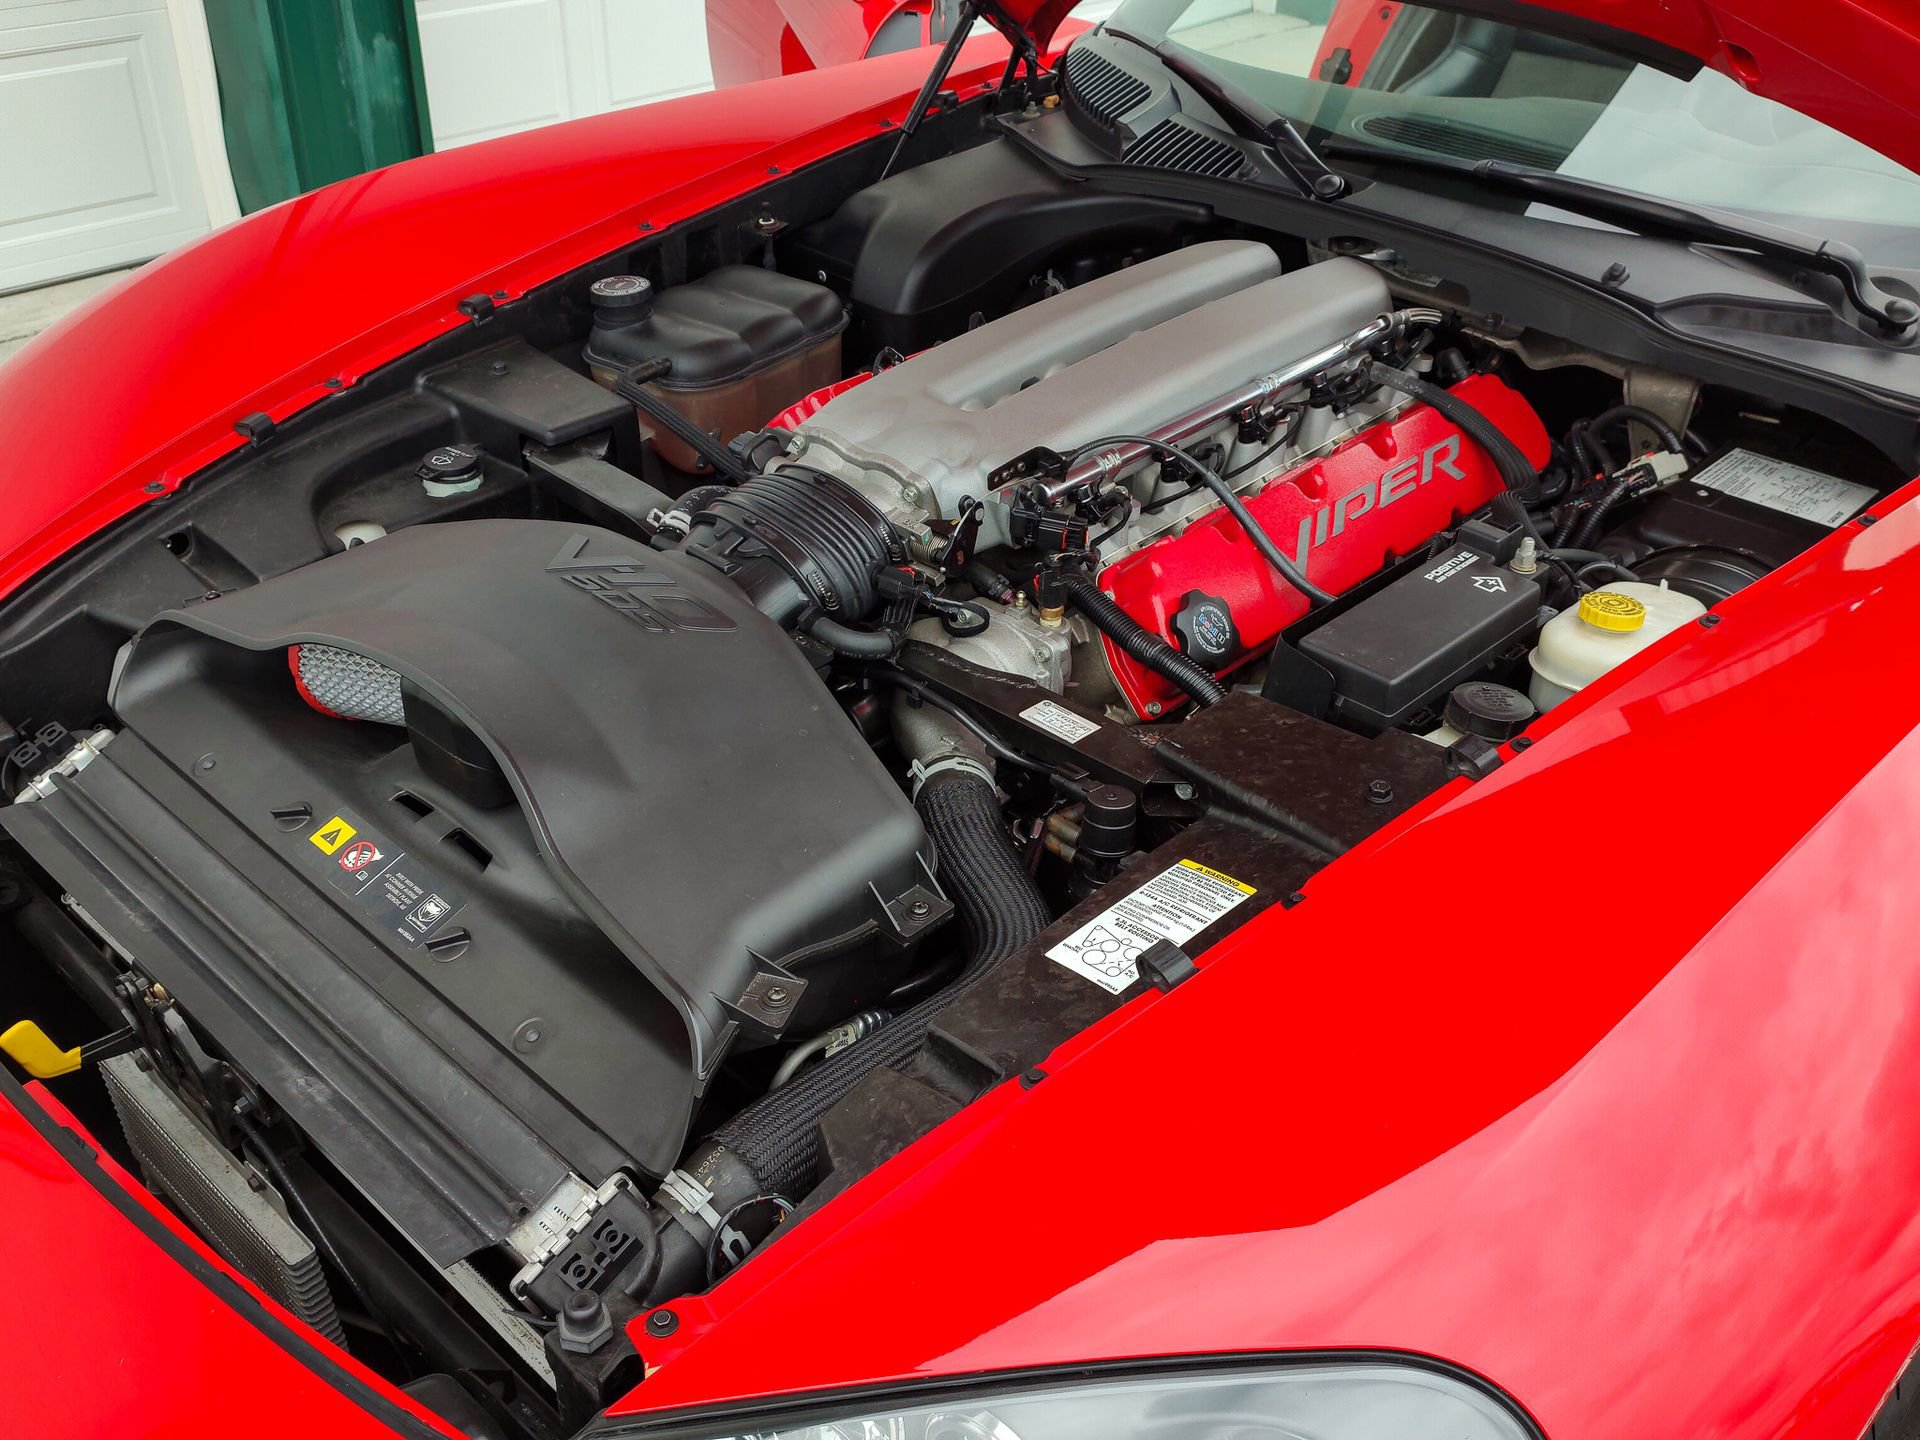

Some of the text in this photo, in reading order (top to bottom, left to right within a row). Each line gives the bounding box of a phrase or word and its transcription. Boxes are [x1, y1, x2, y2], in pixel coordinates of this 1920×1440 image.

[1294, 434, 1466, 579] VIPER
[1424, 551, 1473, 581] POSITIVE
[544, 533, 737, 632] V10
[1171, 868, 1190, 877] SYSTEM
[1202, 882, 1228, 893] SERVICED
[1191, 881, 1220, 895] PERSONNEL
[1203, 869, 1240, 886] WARNING
[1139, 890, 1158, 900] R-134A
[1169, 904, 1208, 923] REFRIGERANT
[1151, 903, 1183, 919] ATTENTION
[1126, 928, 1154, 943] ROUTING
